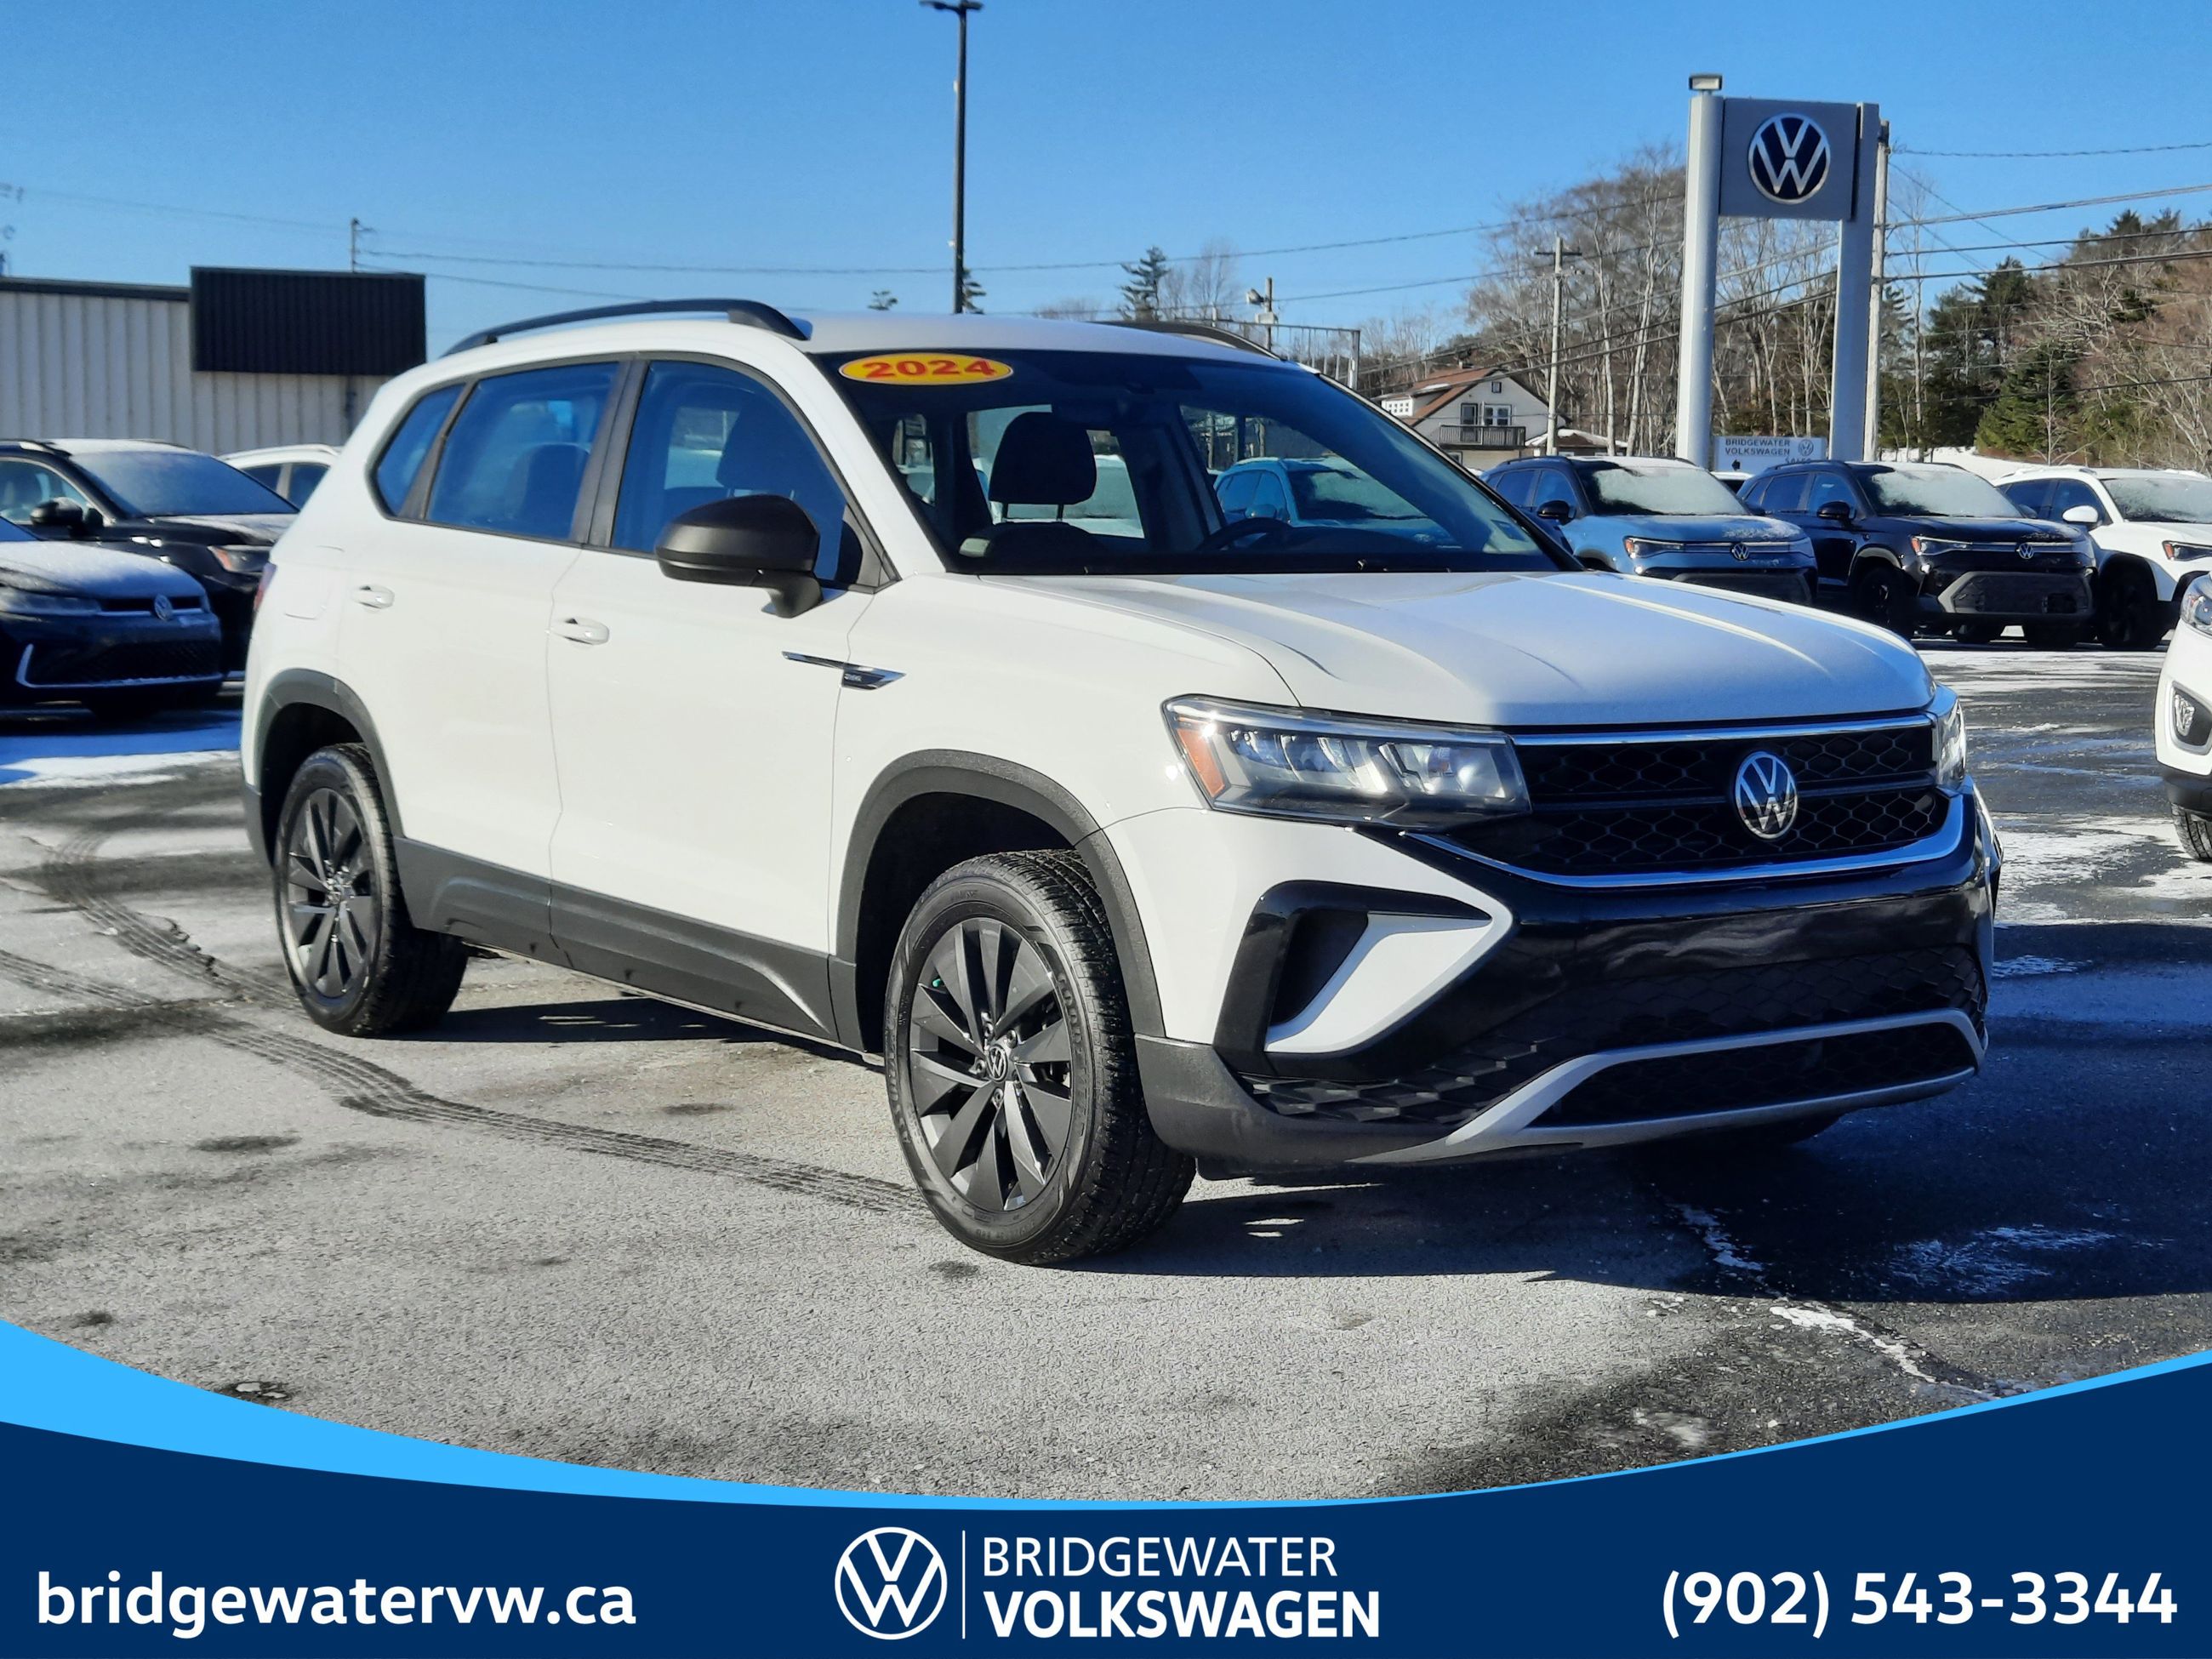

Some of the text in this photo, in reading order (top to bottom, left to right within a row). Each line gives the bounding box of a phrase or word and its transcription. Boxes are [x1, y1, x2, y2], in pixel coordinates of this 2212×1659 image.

[862, 358, 997, 379] 2024
[1725, 438, 1791, 448] BRIDGEWATER
[1725, 447, 1791, 456] VOLKSWAGEN
